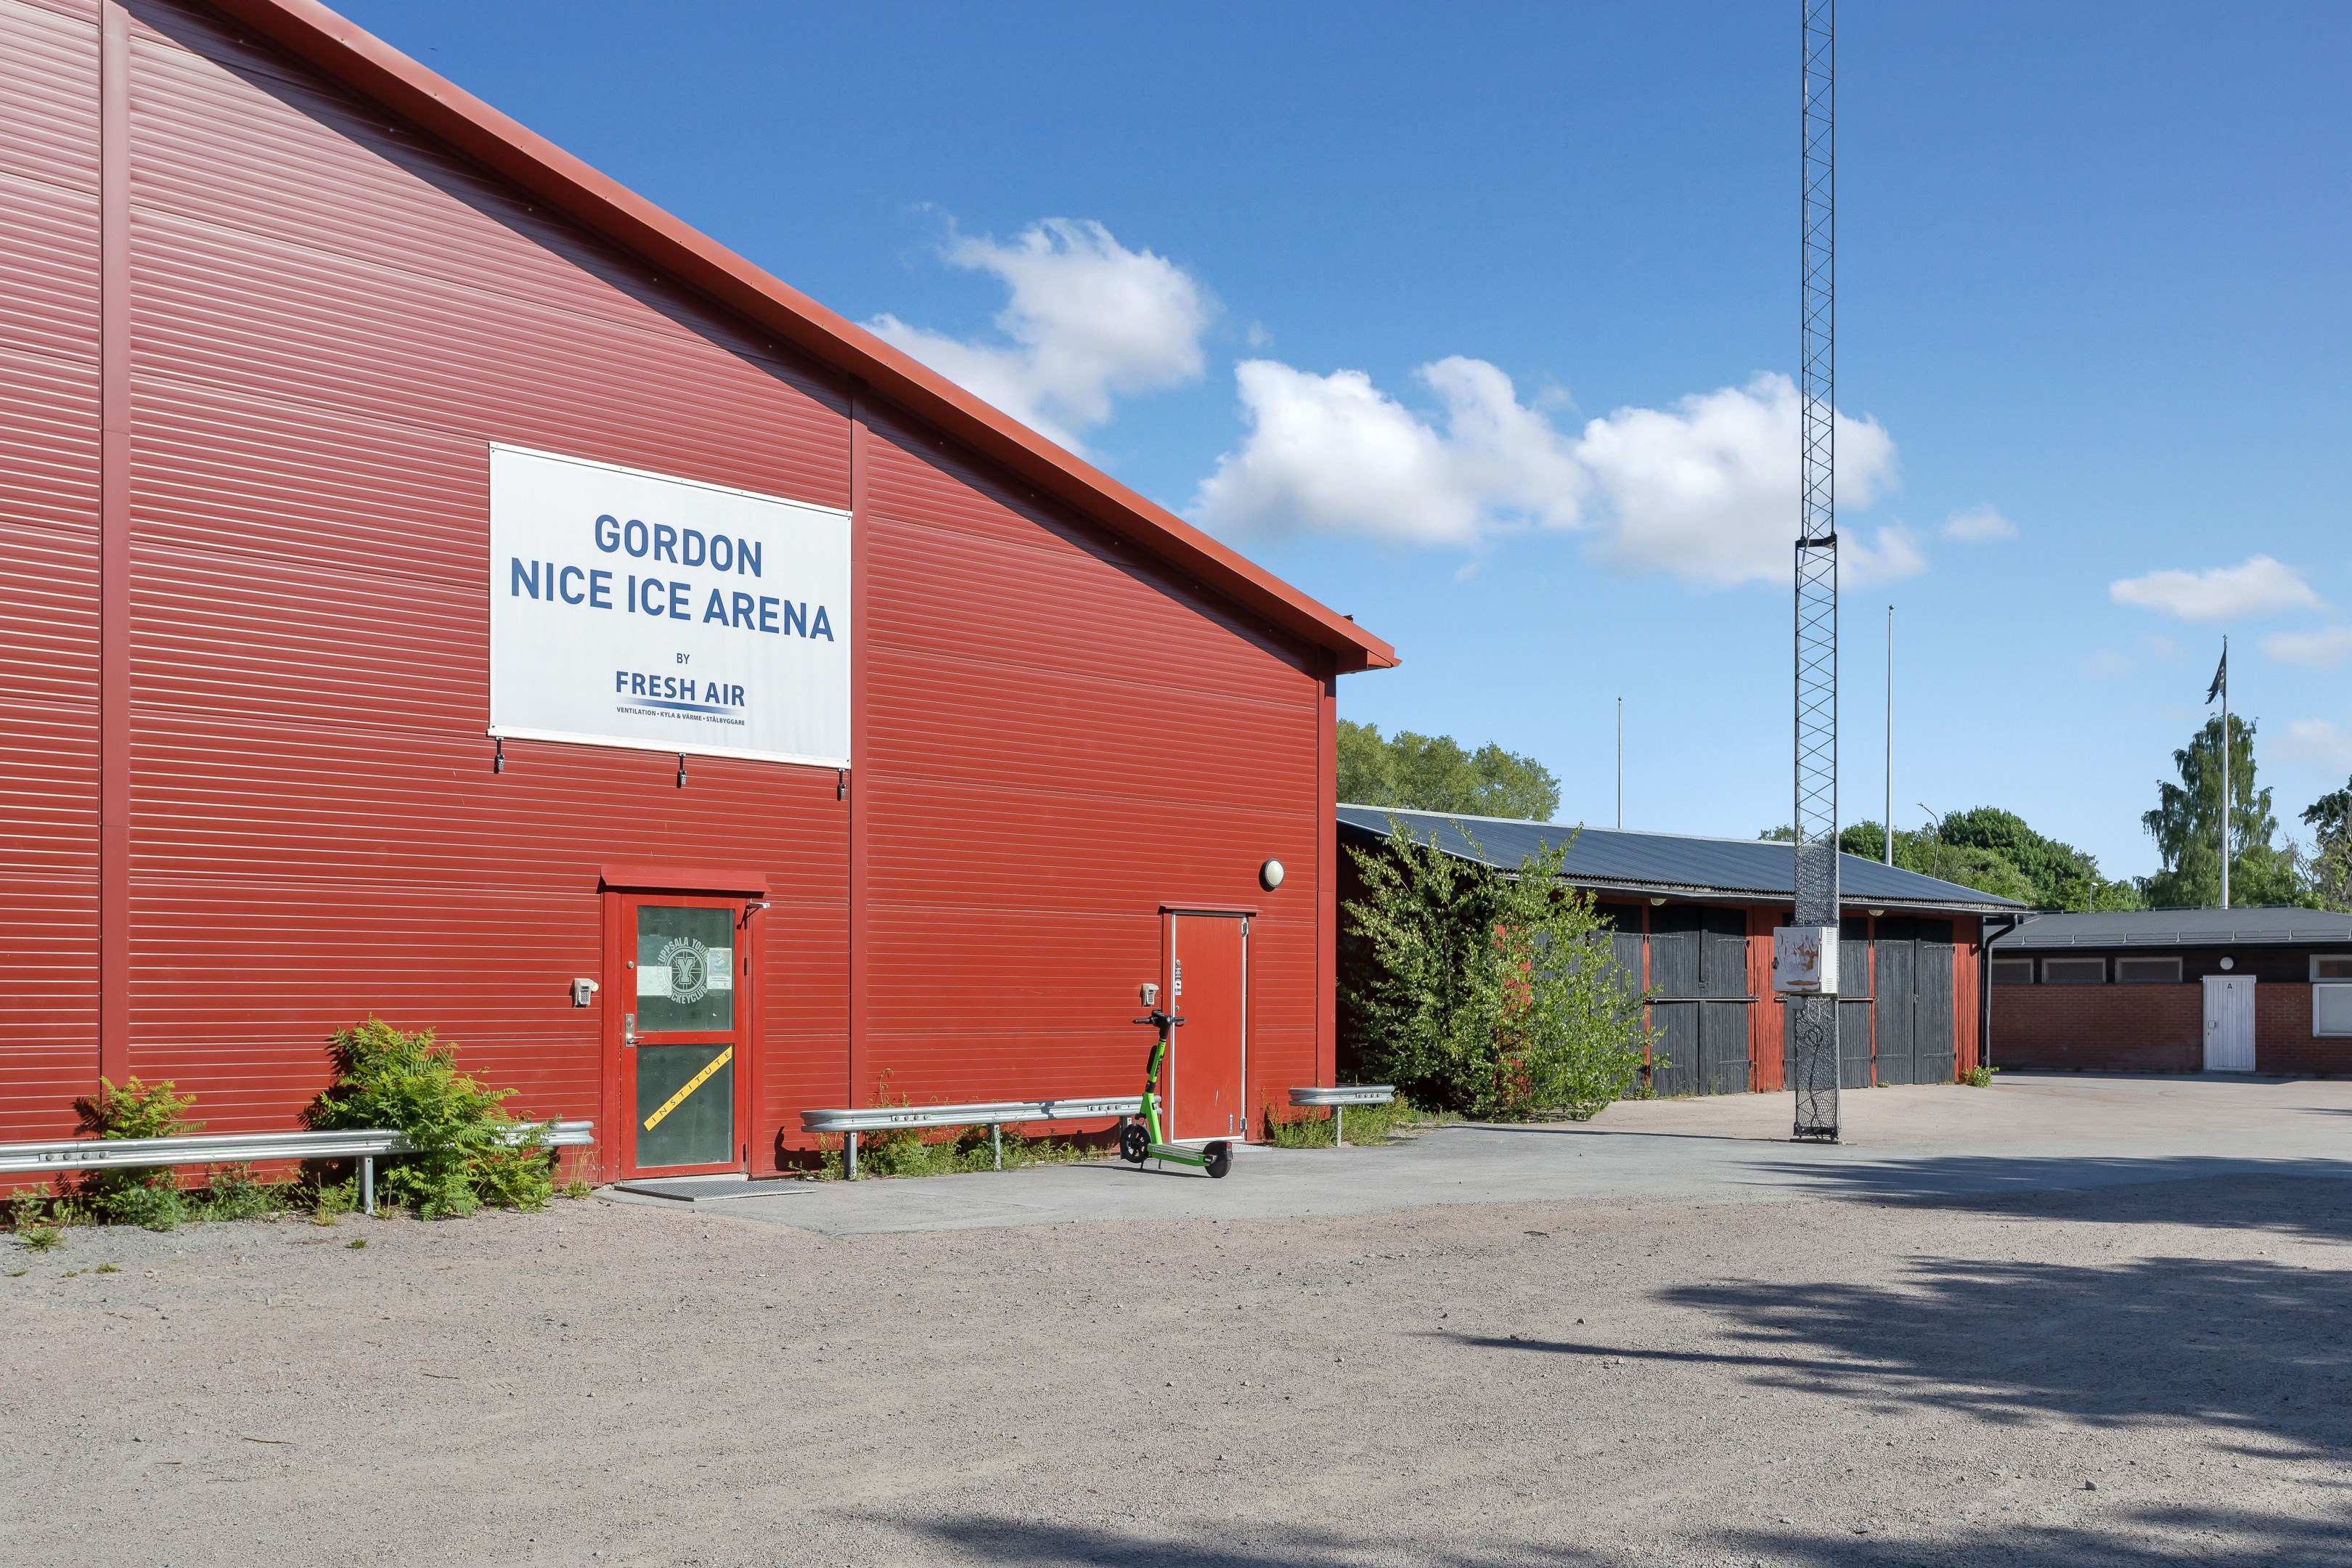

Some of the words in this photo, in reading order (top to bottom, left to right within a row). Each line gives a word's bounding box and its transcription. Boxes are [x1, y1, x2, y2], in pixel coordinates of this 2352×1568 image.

[595, 514, 762, 578] GORDON
[511, 557, 613, 610] NICE
[628, 574, 691, 621] ICE
[703, 588, 835, 642] ARENA
[677, 653, 690, 664] BY
[616, 671, 695, 701] FRESH
[704, 682, 746, 707] AIR
[616, 706, 656, 716] VENTILATION
[682, 712, 702, 721] VÄRME
[706, 715, 745, 725] STÅLBYGGARE
[657, 936, 689, 963] UPPSALA
[652, 1051, 730, 1122] INSTITUTE
